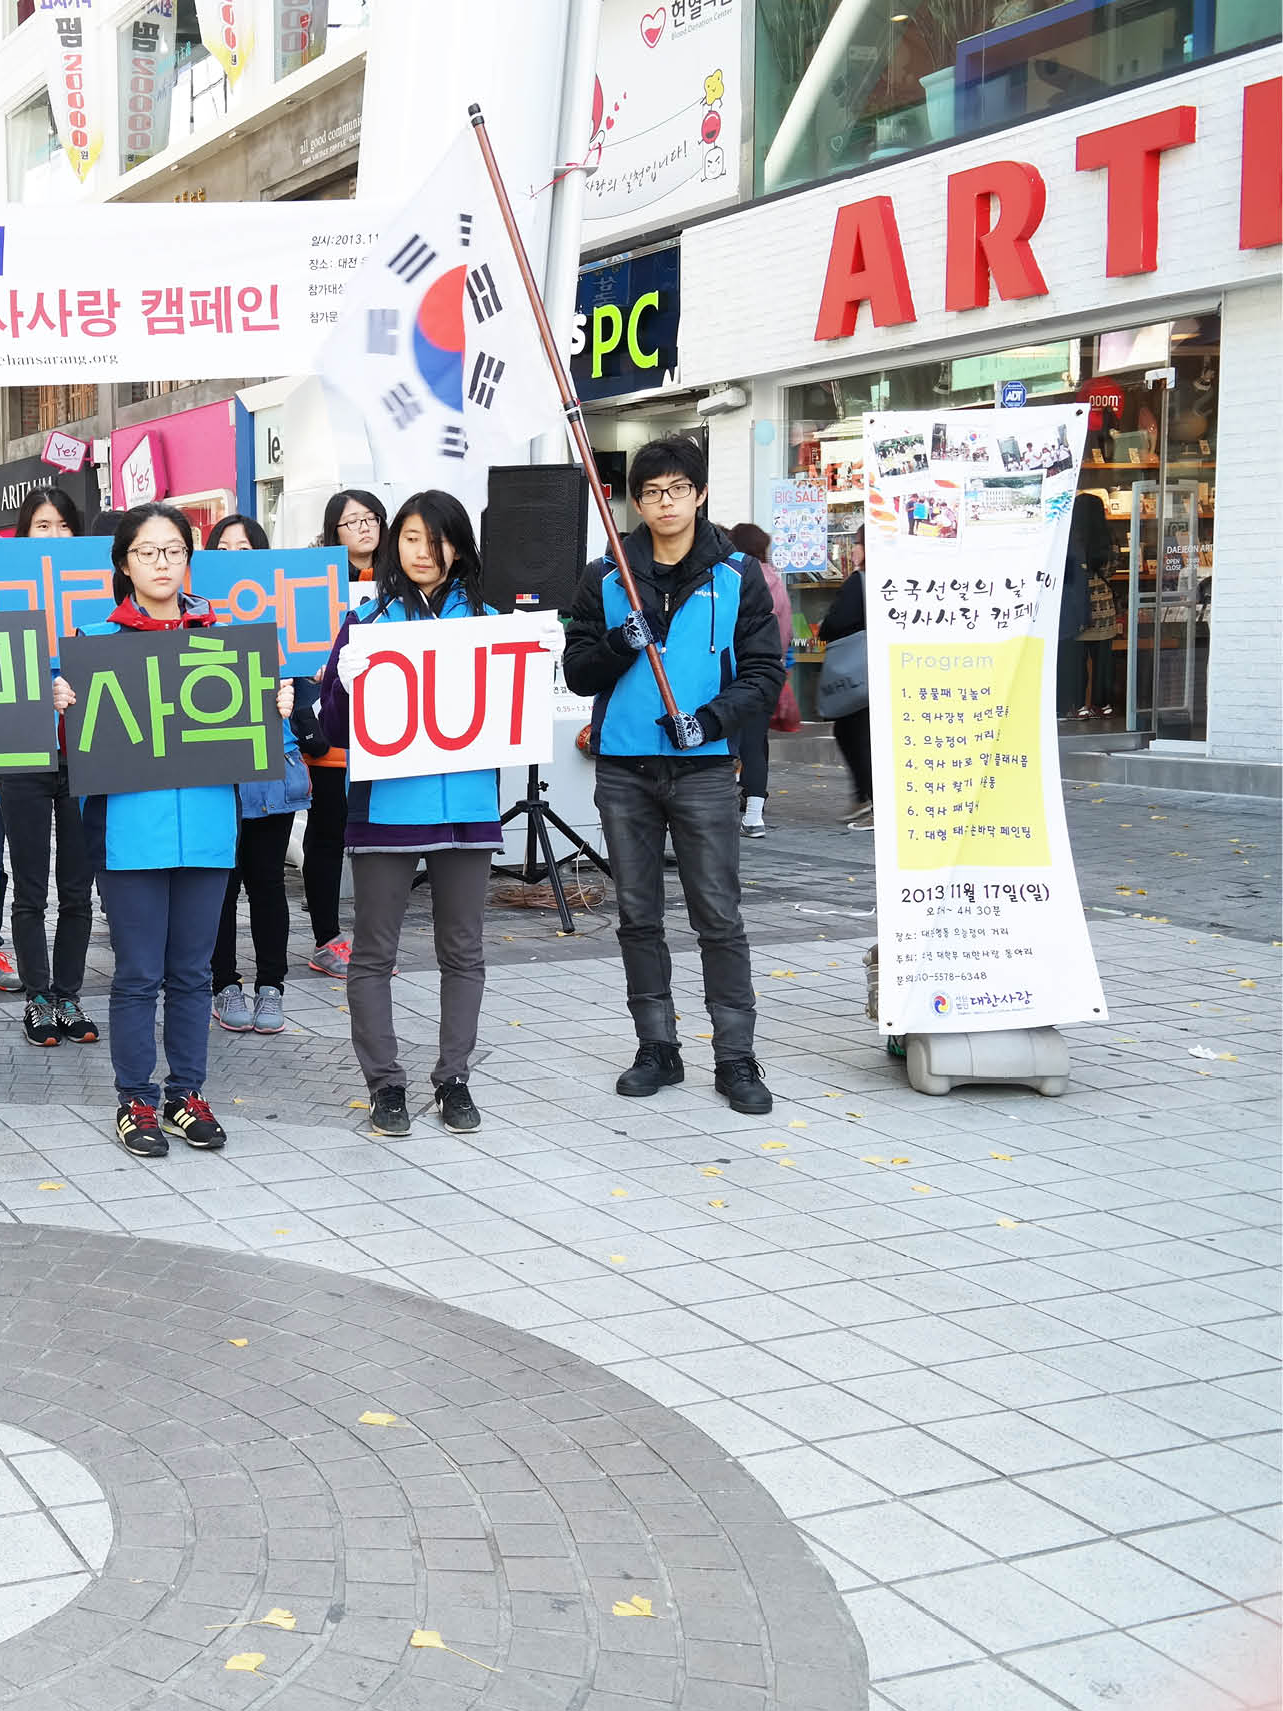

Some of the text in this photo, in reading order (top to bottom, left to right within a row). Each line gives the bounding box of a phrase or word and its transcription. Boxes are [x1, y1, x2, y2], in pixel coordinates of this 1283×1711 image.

[140, 284, 281, 333] 캠페인
[1005, 390, 1024, 403] ADT
[795, 487, 825, 504] SALE
[990, 602, 1041, 630] 캠페
[900, 651, 995, 672] Program
[353, 640, 550, 757] OUT
[901, 687, 912, 699] 1.
[78, 634, 276, 771] 사학
[902, 712, 916, 722] 2.
[904, 735, 917, 747] 3.
[905, 759, 918, 770] 4.
[906, 781, 919, 793] 5.
[907, 806, 919, 817] 6.
[907, 829, 920, 841] 7.
[983, 883, 1051, 903] 17일(일)
